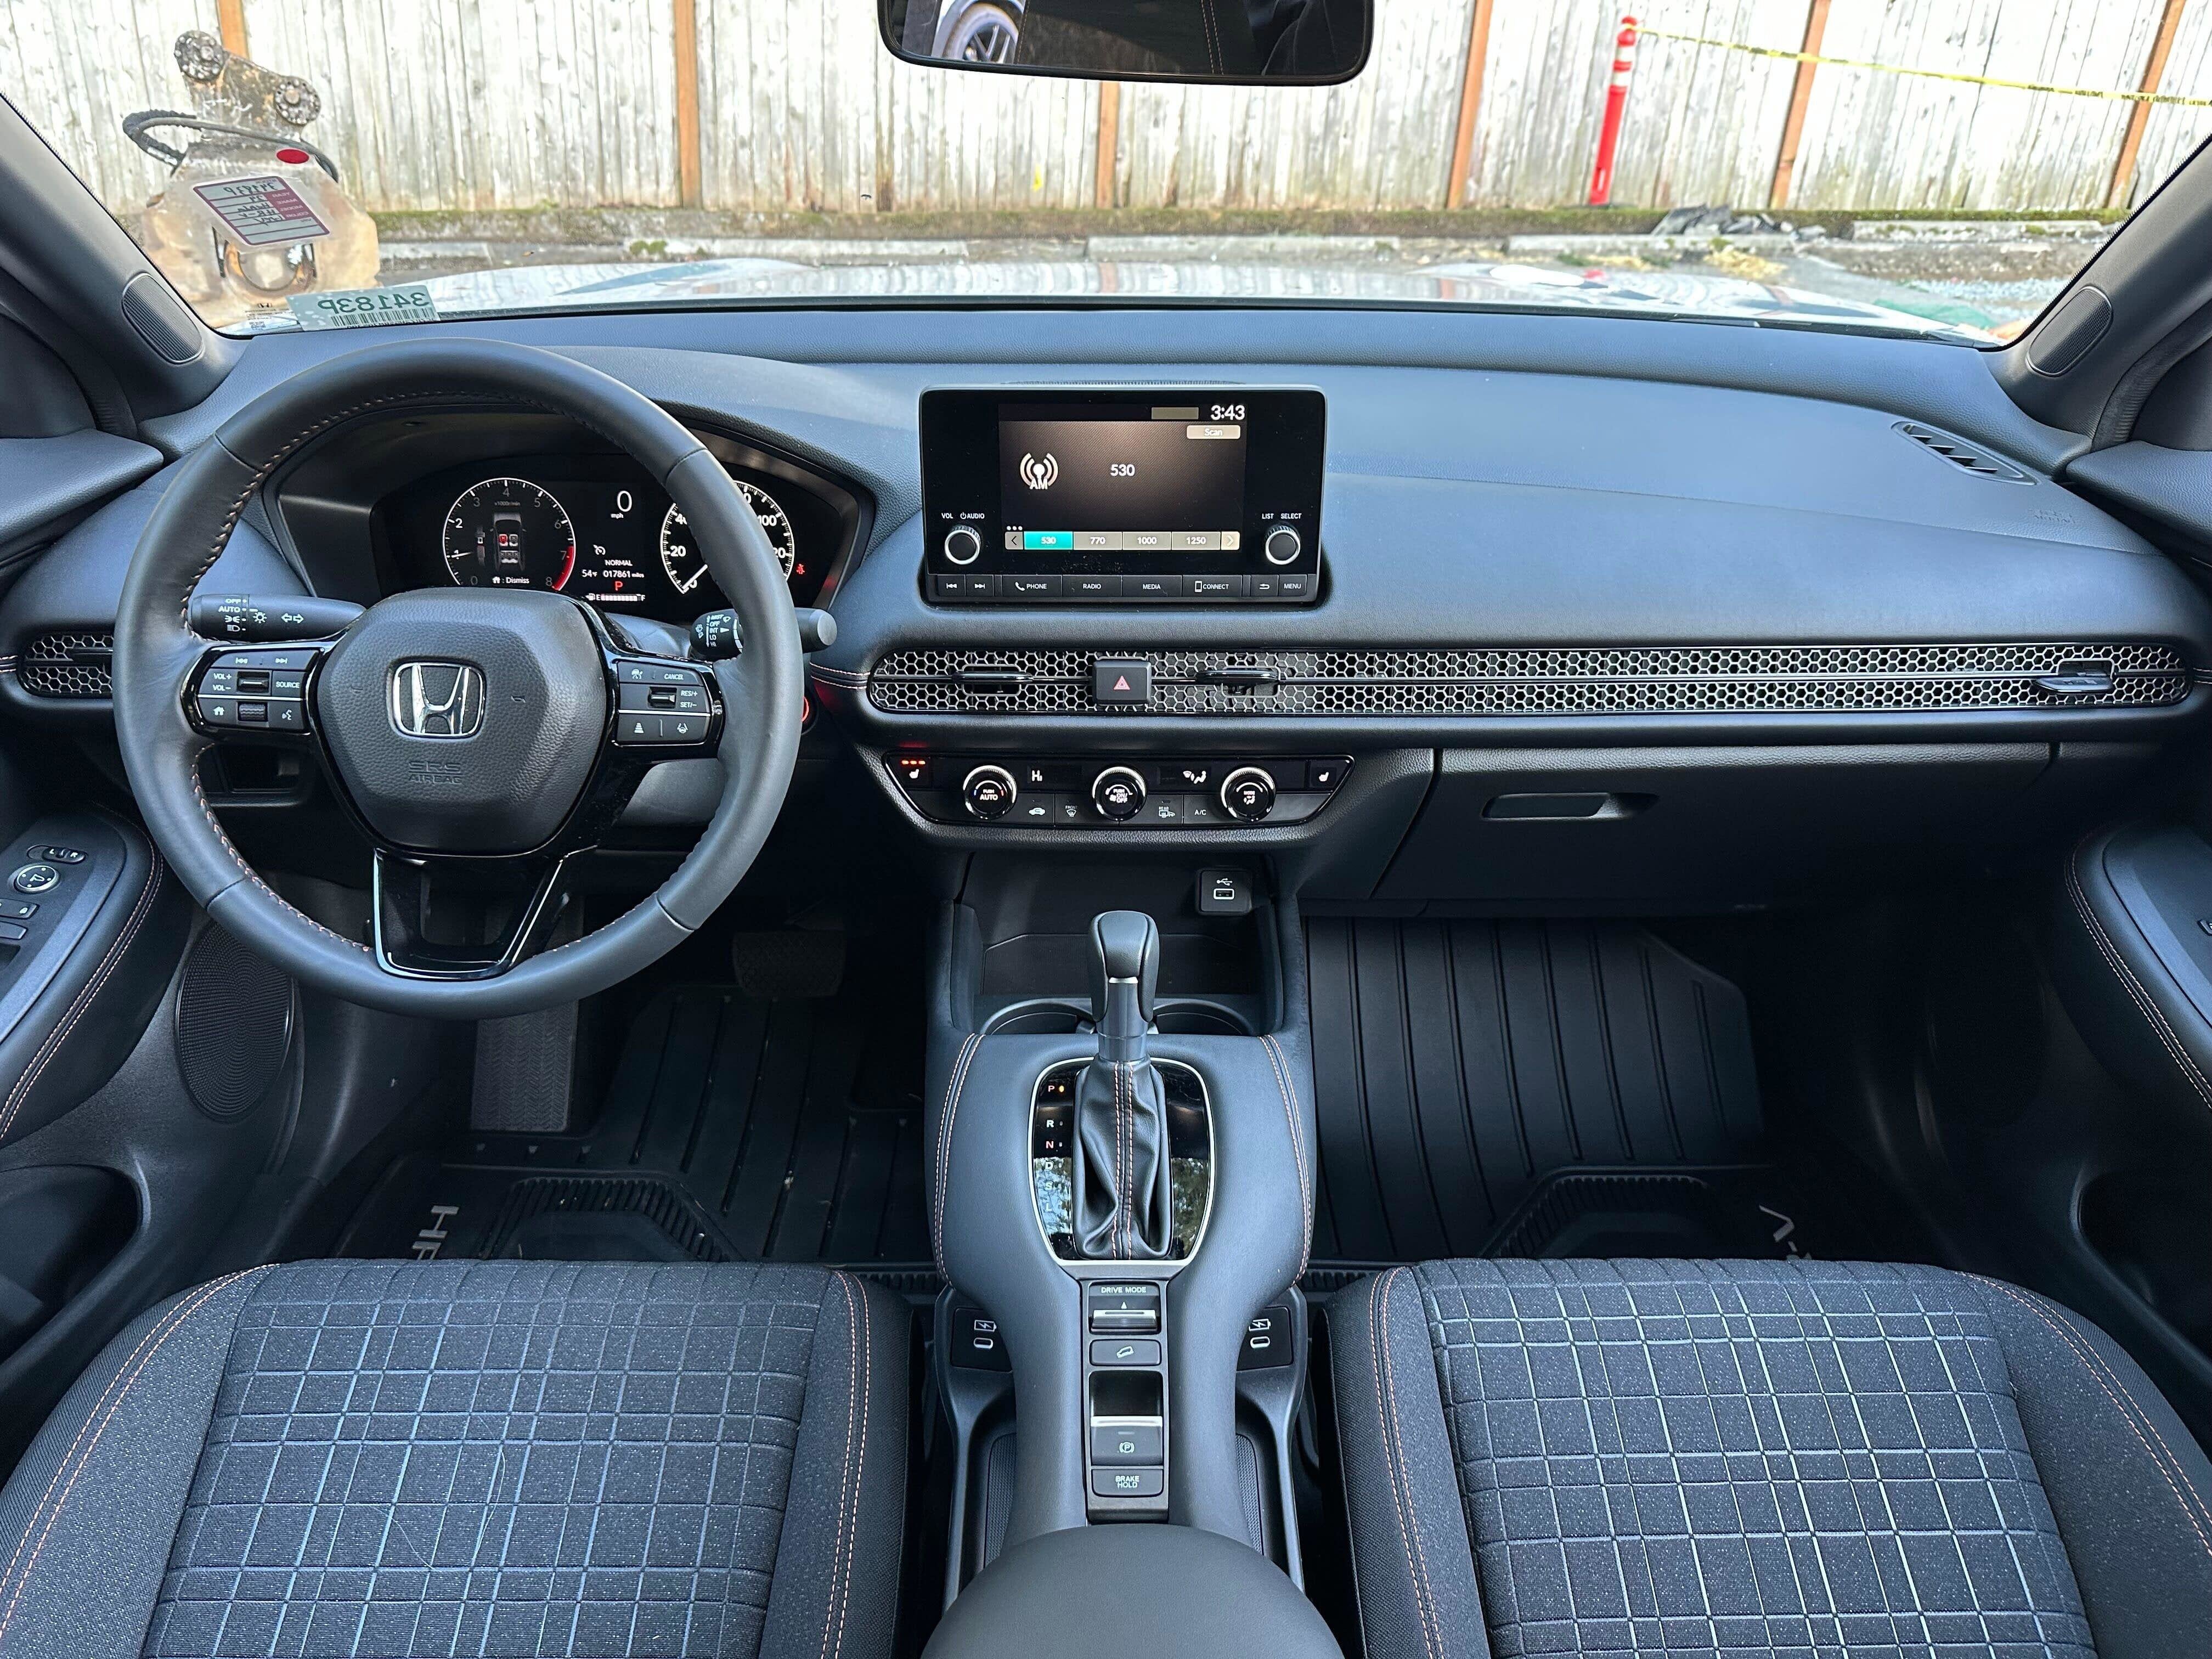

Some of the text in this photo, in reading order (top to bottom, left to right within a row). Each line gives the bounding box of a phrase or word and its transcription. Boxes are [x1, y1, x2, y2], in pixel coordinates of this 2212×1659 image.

[1211, 405, 1245, 420] 3:43
[1110, 464, 1136, 477] 530
[1029, 478, 1048, 489] AM
[503, 488, 509, 496] 4
[473, 497, 480, 506] 3
[534, 498, 541, 507] 5
[617, 490, 632, 512] 0
[455, 518, 463, 528] 2
[555, 520, 561, 529] 6
[1041, 537, 1206, 545] 530 770 1000 1250
[561, 550, 567, 560] 7
[670, 545, 686, 557] 20
[471, 576, 478, 585] 0
[545, 577, 552, 586] 8
[615, 581, 623, 591] P
[409, 760, 461, 773] SRS
[1045, 1161, 1053, 1170] D
